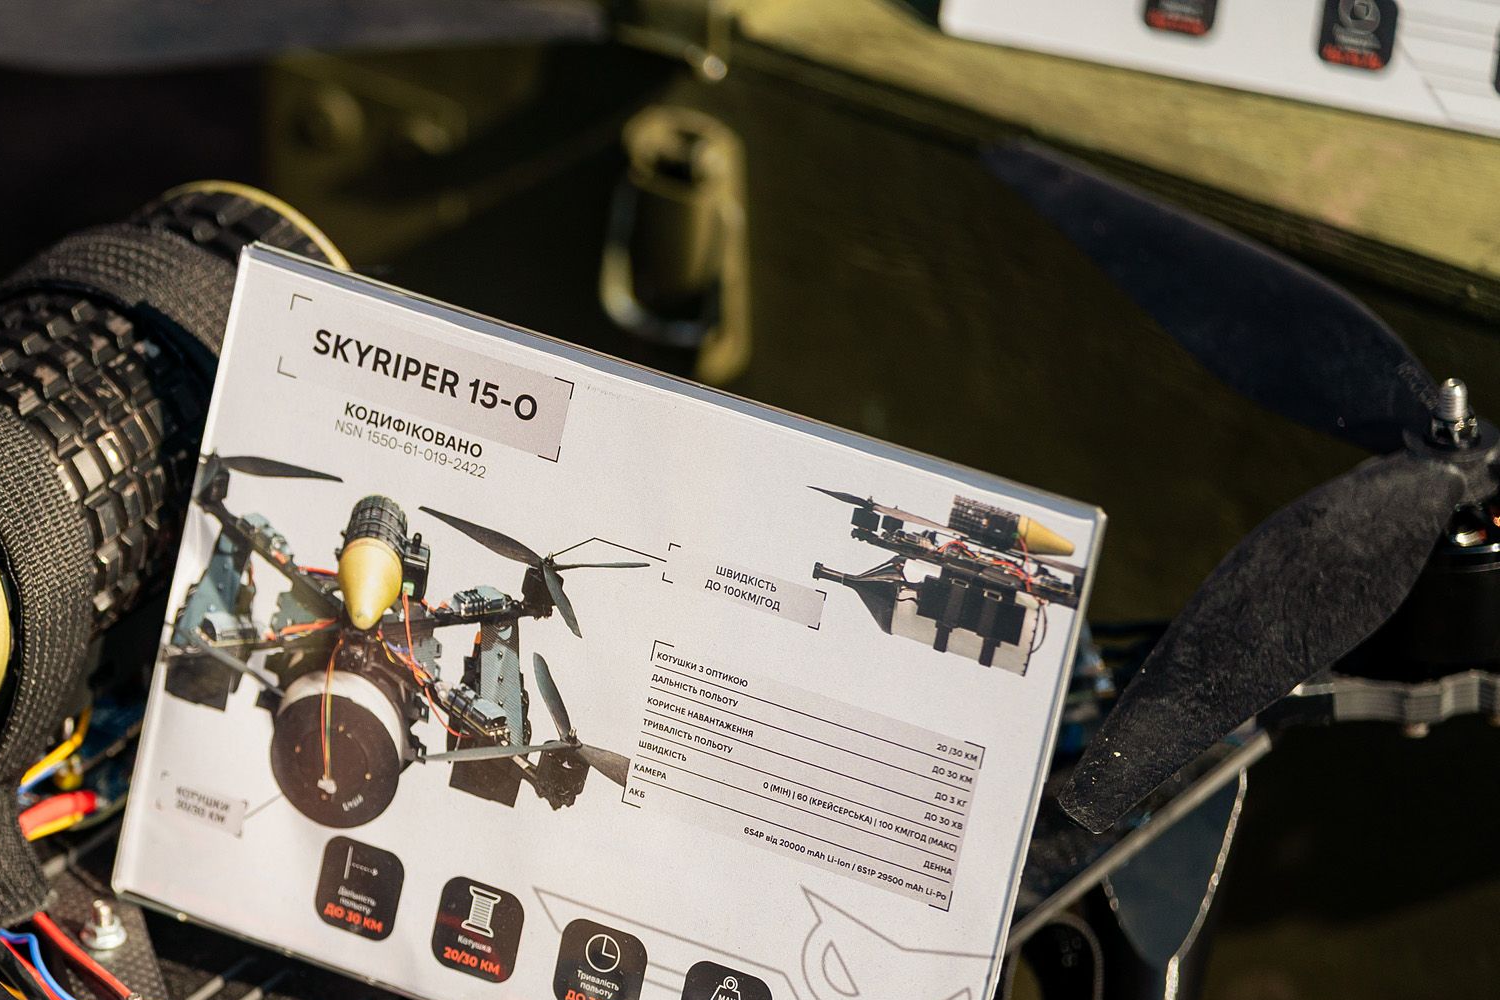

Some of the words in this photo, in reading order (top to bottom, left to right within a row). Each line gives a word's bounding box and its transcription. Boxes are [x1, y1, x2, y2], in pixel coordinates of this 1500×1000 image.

[312, 328, 460, 398] SKYRIPER
[344, 402, 483, 458] КОДИФІКОВАНО
[334, 419, 363, 438] NSN
[367, 430, 487, 479] 1550-61-019-2422
[715, 565, 777, 593] ШВИДКІСТЬ
[704, 579, 721, 592] ДО
[724, 585, 781, 612] 100КМ/ГОД
[657, 651, 697, 671] КОТУШКИ
[706, 668, 748, 687] ОПТИКОЮ
[652, 673, 698, 694] ДАЛЬНІСТЬ
[700, 689, 739, 707] ПОЛЬОТУ
[647, 697, 686, 715] КОРИСНЕ
[687, 709, 754, 738] НАВАНТАЖЕННЯ
[643, 718, 692, 740] ТРИВАЛІСТЬ
[694, 735, 733, 754] ПОЛЬОТУ
[638, 740, 687, 762] ШВИДКІСТЬ
[936, 743, 947, 752] 20
[964, 752, 978, 762] КМ
[634, 763, 667, 780] КАМЕРА
[932, 765, 945, 775] ДО
[947, 770, 958, 779] 30
[959, 774, 973, 784] КМ
[629, 787, 645, 799] АКБ
[934, 792, 948, 801] ДО
[956, 799, 968, 807] КГ
[770, 783, 792, 798] (МІН)
[797, 793, 808, 802] 60
[809, 796, 873, 825] (КРЕЙСЕРСЬКА)
[879, 820, 893, 830] 100
[894, 825, 927, 843] КМ/ГОД
[928, 836, 958, 853] (МАКС)
[924, 811, 937, 821] ДО
[939, 817, 950, 826] 30
[951, 821, 963, 830] ХВ
[765, 835, 778, 845] від
[779, 839, 806, 853] 20000
[807, 849, 825, 860] mAh
[877, 871, 904, 886] 29500
[905, 881, 924, 893] mAh
[925, 887, 947, 900] Li-Po
[923, 860, 952, 876] ДЕННА
[324, 903, 345, 920] ДО
[362, 915, 384, 933] КМ
[443, 946, 478, 968] 20/30
[479, 958, 501, 975] КМ
[577, 969, 620, 991] Тривалість
[580, 981, 613, 999] польоту
